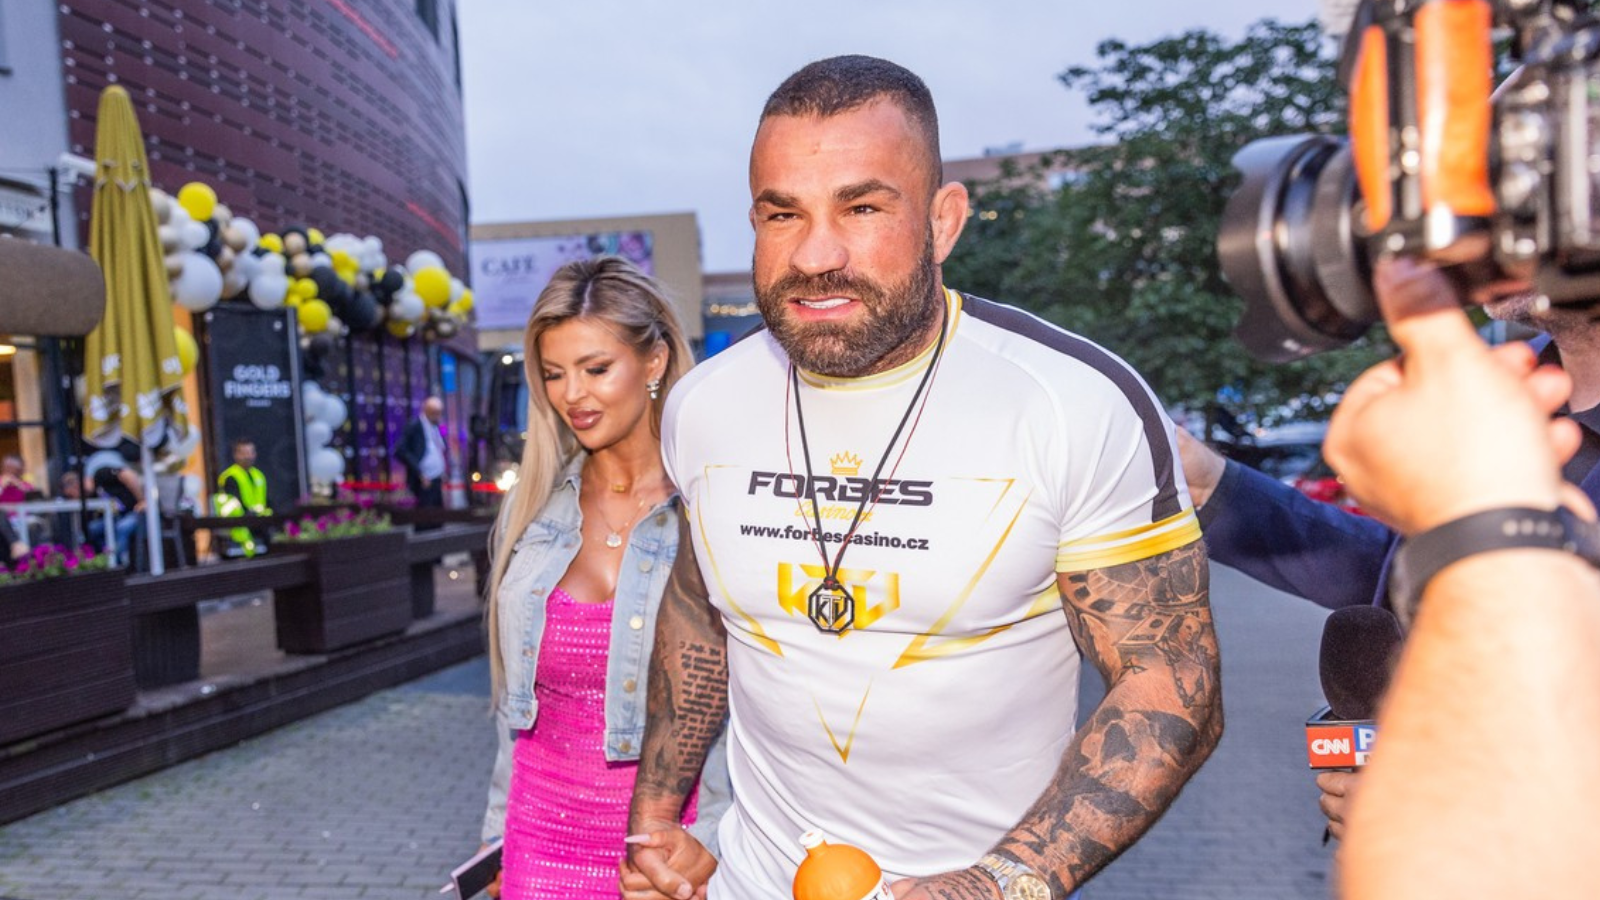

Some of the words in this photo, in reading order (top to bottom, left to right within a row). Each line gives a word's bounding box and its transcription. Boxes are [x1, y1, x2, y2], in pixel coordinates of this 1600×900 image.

[233, 364, 280, 381] GOLD
[224, 380, 291, 398] FINGERS
[748, 470, 934, 507] FORBES
[740, 524, 929, 550] www.forbescasino.cz
[1311, 738, 1350, 755] CNN
